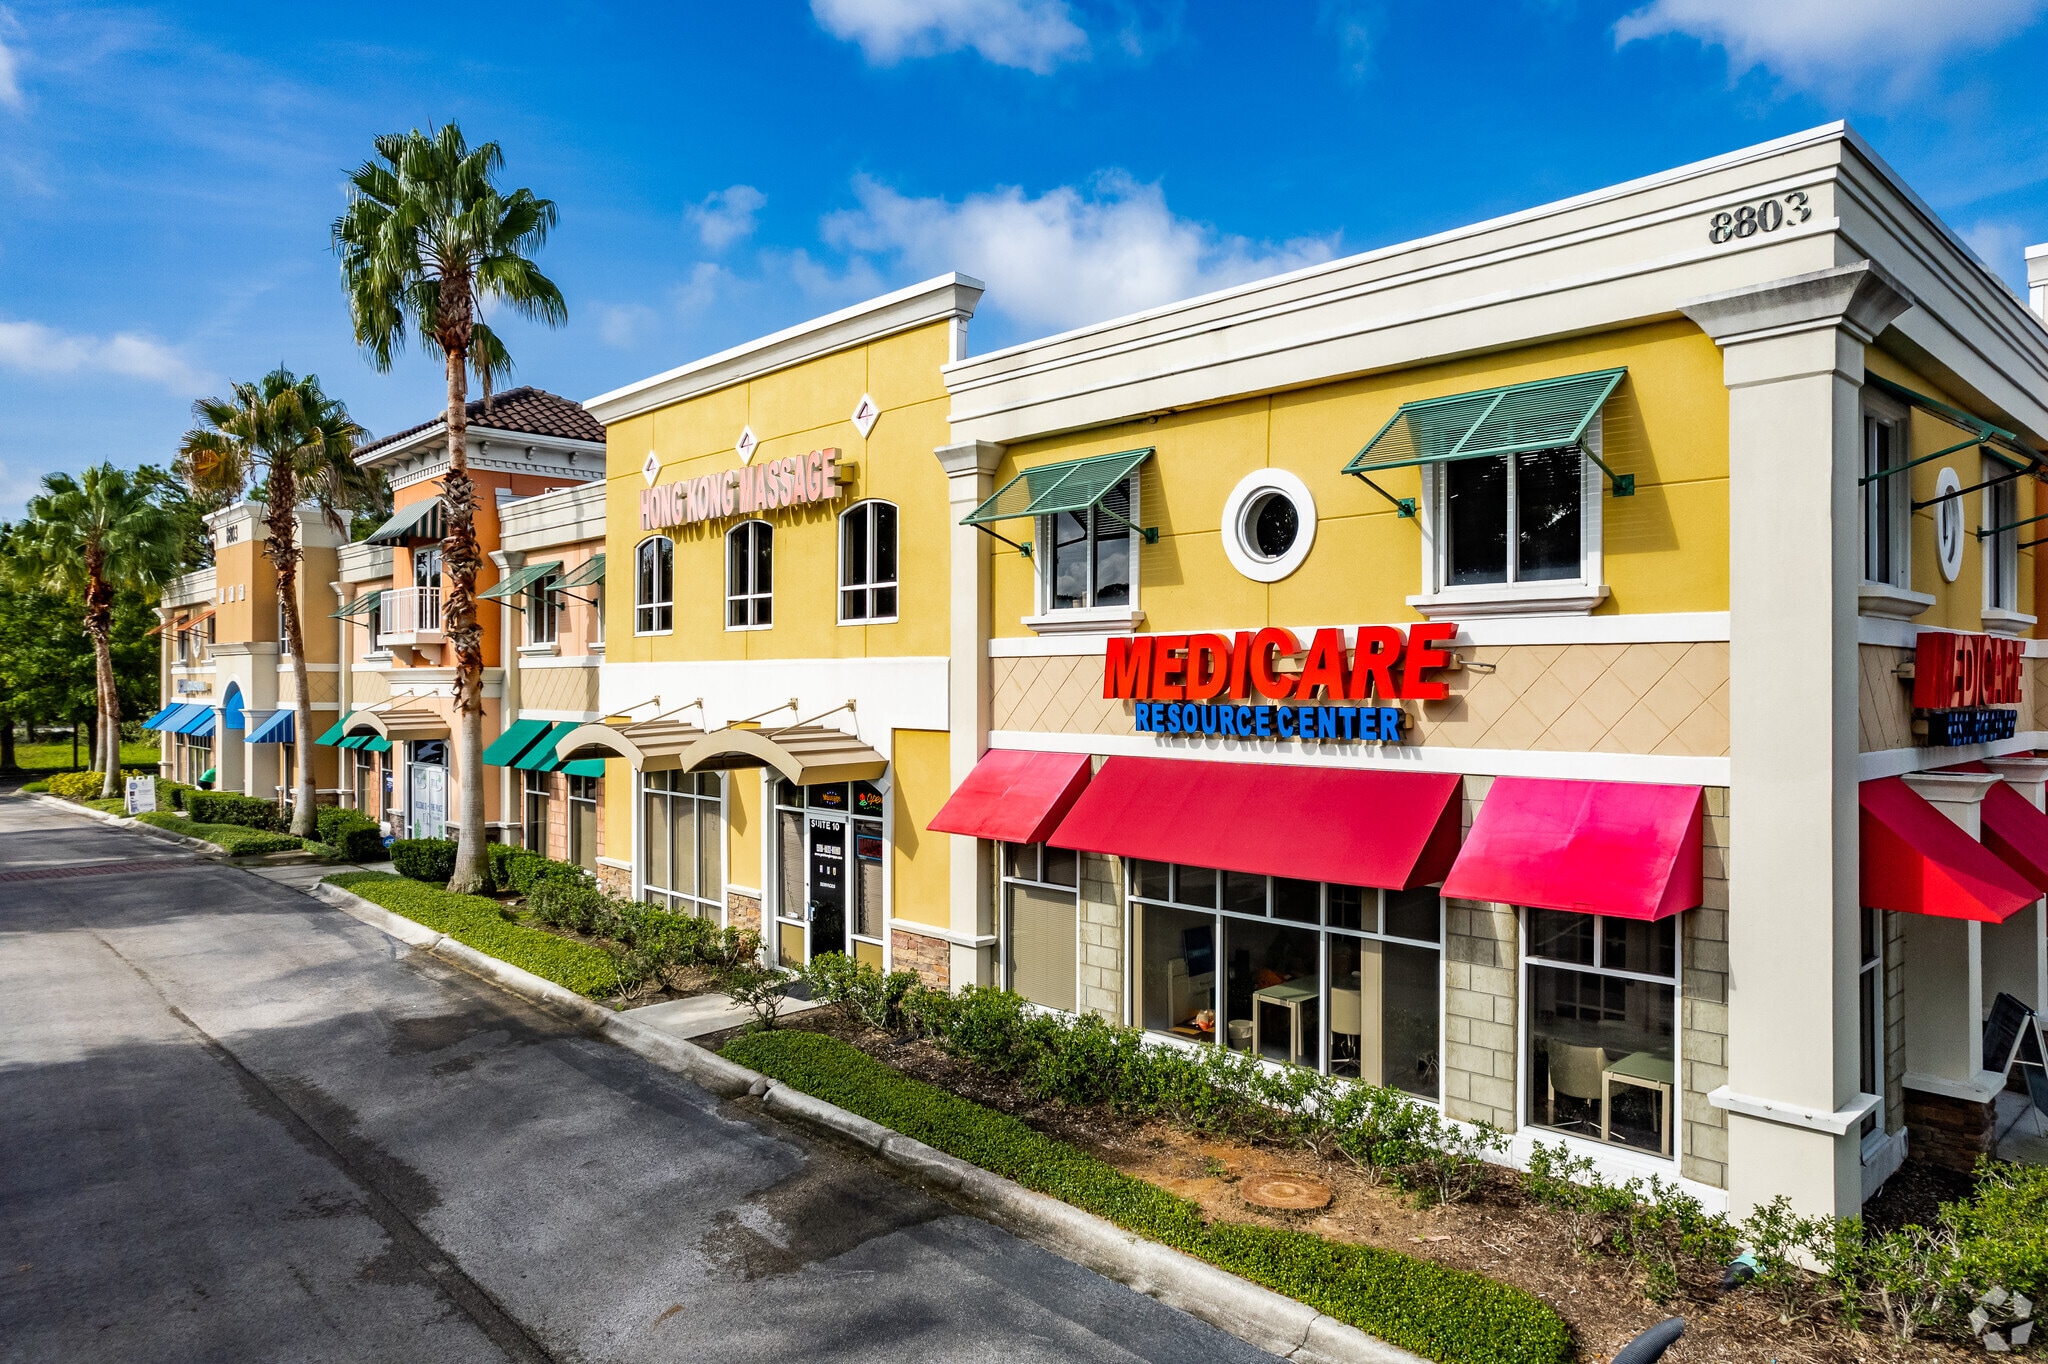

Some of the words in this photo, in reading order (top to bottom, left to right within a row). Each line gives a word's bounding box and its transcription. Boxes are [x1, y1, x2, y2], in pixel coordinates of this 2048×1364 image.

[1708, 191, 1812, 244] 8803
[640, 481, 687, 531] HONG
[686, 469, 741, 523] KONG
[739, 447, 843, 514] MASSAGE
[1103, 622, 1459, 700] MEDICARE
[1913, 631, 2026, 709] EDICARE
[1135, 702, 1278, 737] RESOURCE
[1277, 706, 1406, 742] CENTER
[811, 819, 831, 830] SUITE
[832, 822, 840, 831] 10
